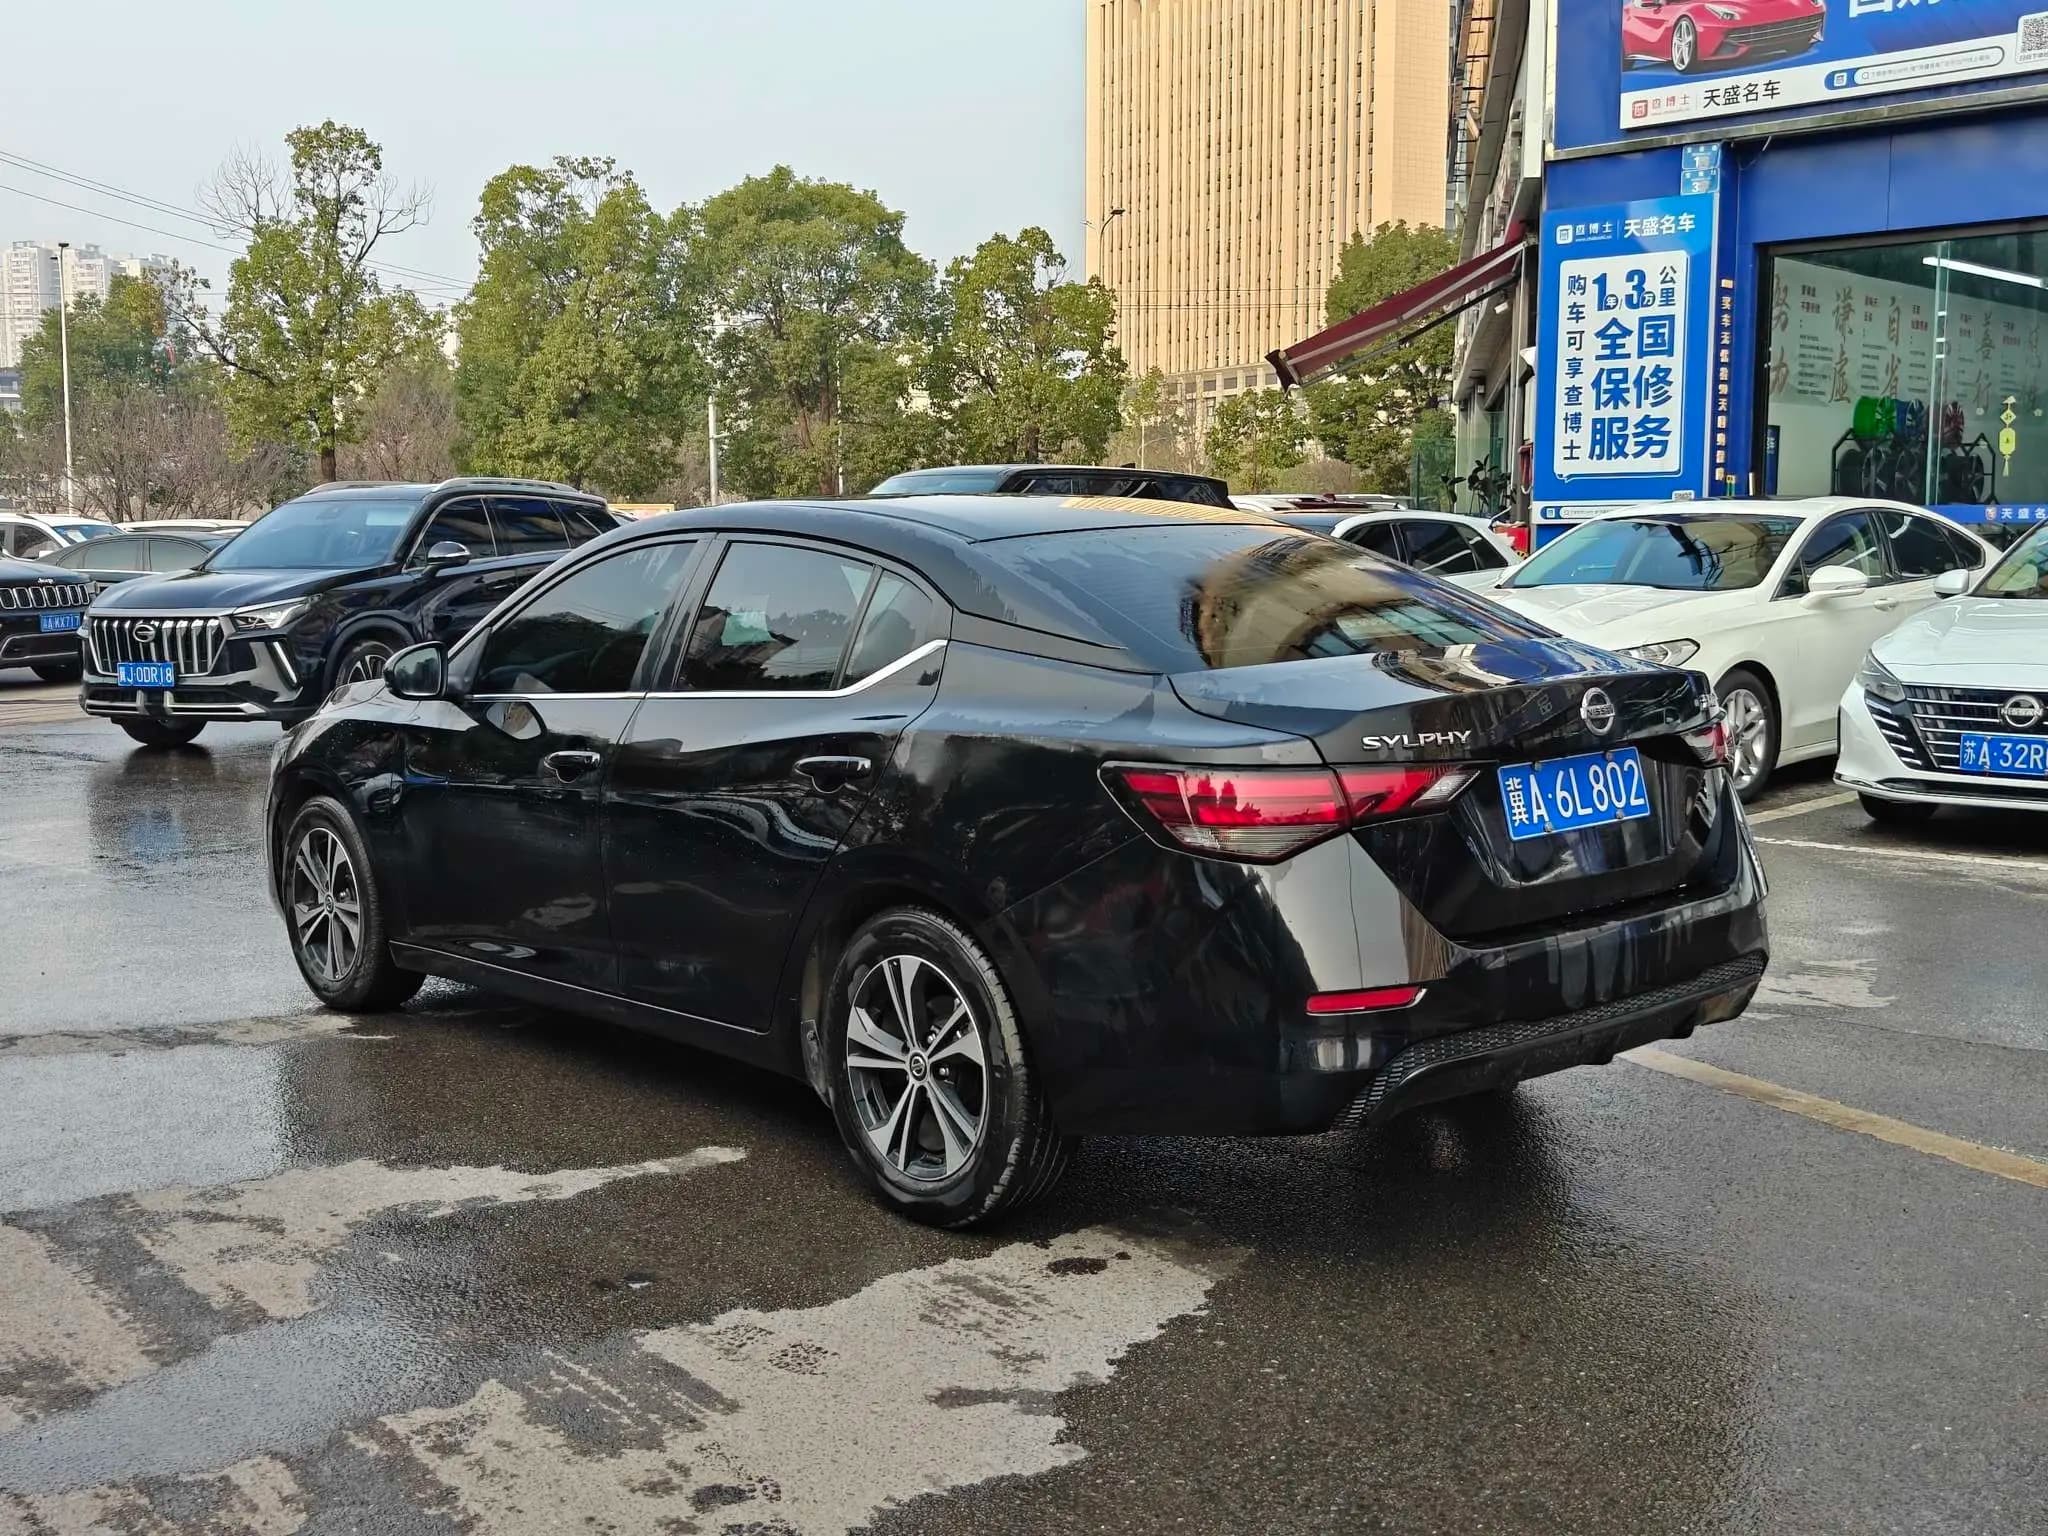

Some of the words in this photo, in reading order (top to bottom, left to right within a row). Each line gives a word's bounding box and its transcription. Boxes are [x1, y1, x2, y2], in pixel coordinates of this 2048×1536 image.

[1703, 79, 1781, 109] 天盛名车
[1624, 212, 1696, 239] 天盛名车
[1593, 314, 1676, 361] 全国
[1562, 274, 1587, 461] 购车可享查博士
[1590, 364, 1674, 411] 保修
[1588, 414, 1672, 461] 服务
[2001, 707, 2043, 717] NISSAN
[1362, 730, 1472, 750] SYLPHY
[1963, 740, 2048, 770] 苏A·32R
